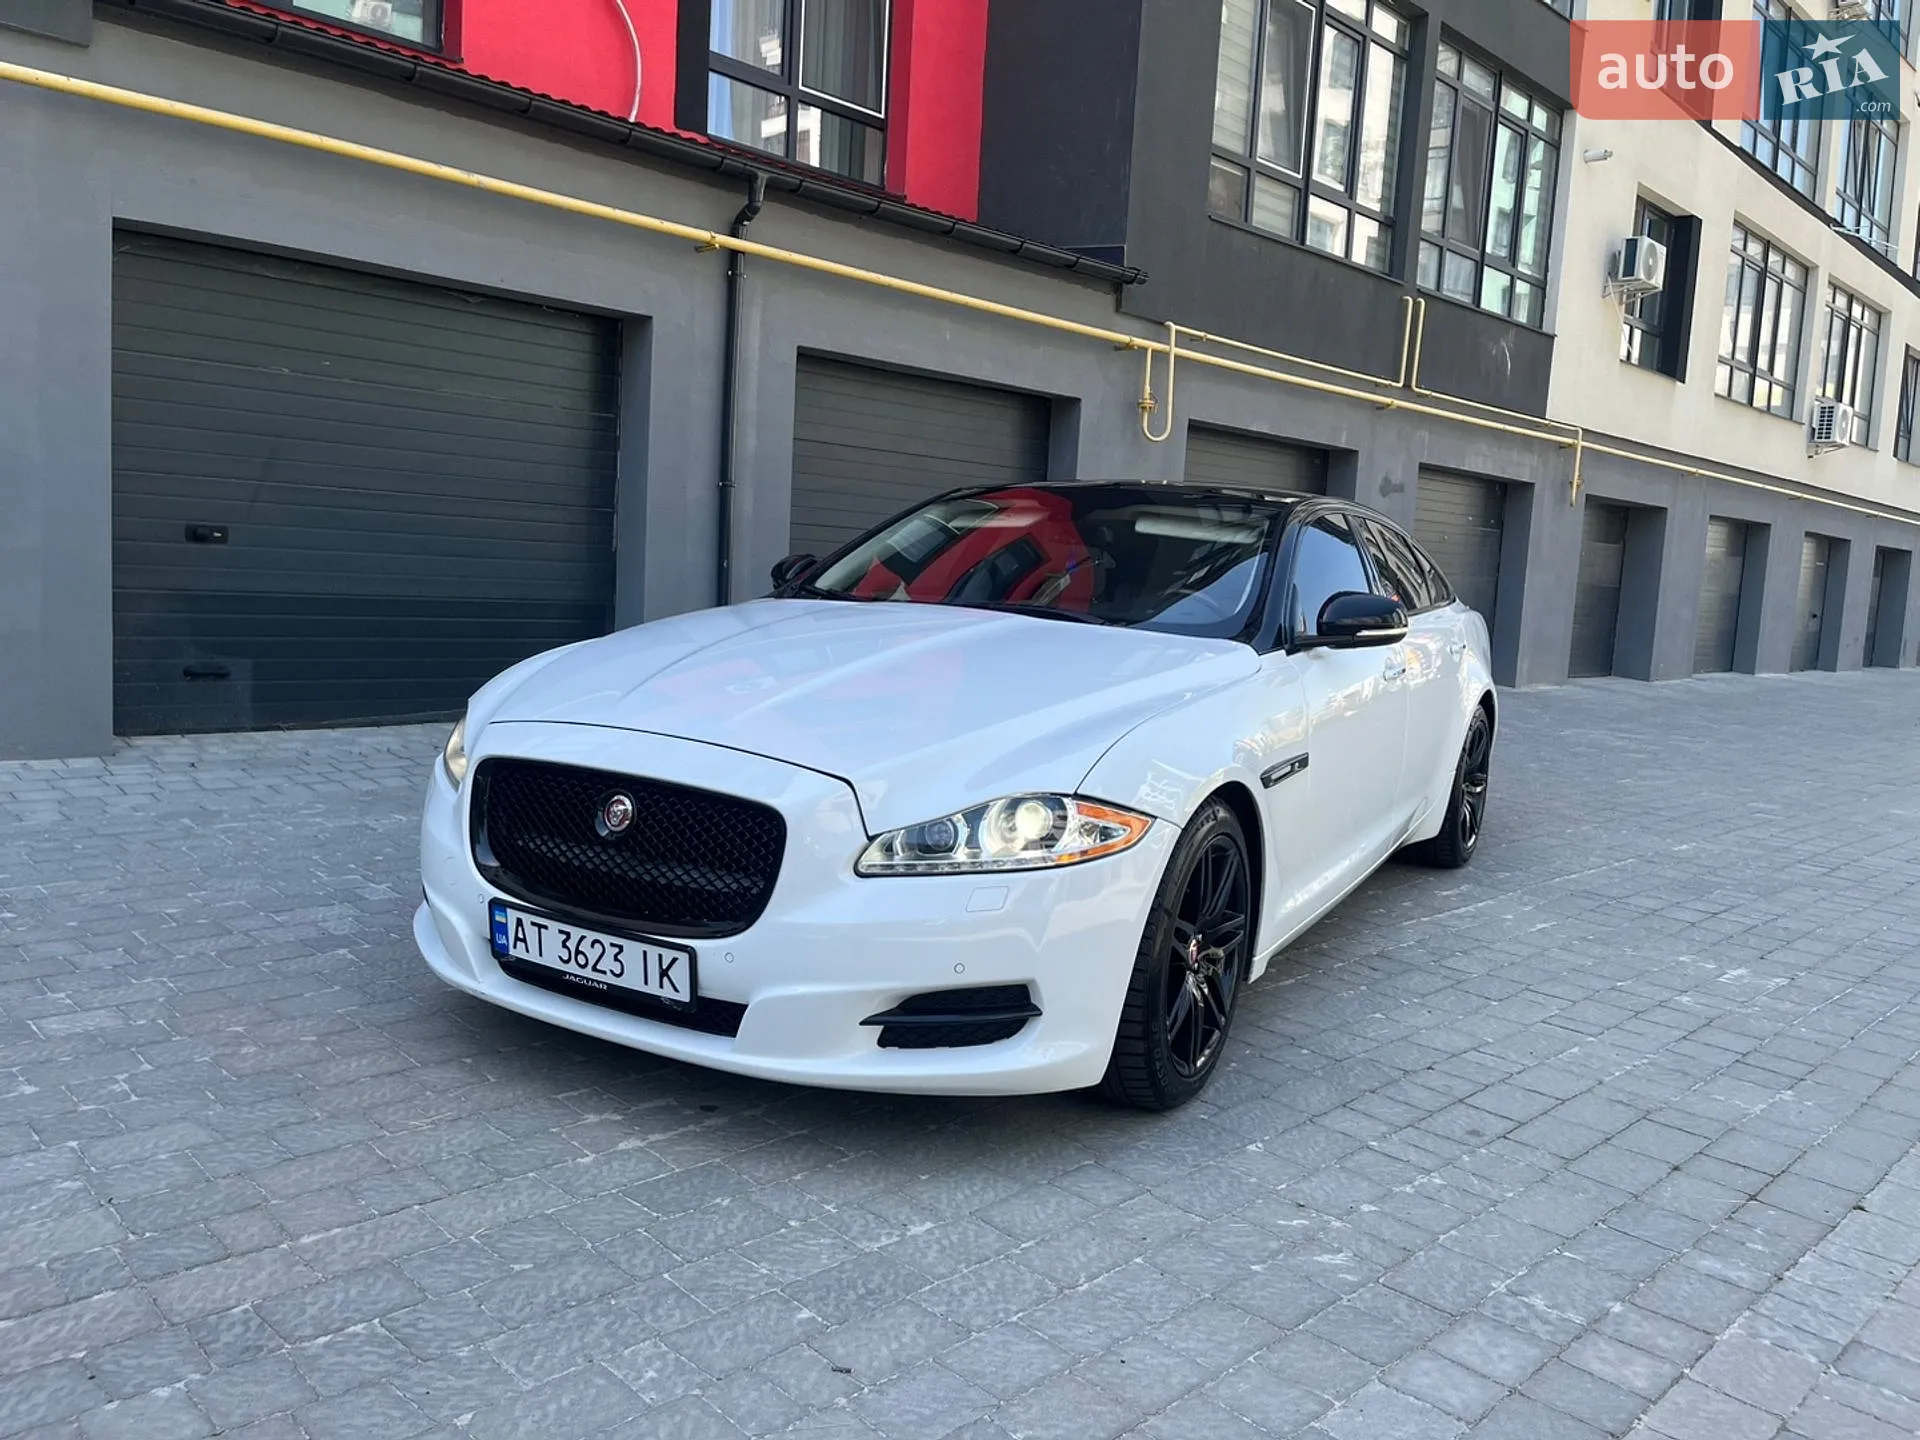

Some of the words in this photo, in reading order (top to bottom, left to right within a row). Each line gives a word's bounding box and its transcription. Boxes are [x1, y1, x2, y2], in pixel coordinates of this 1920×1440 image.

[495, 932, 508, 946] UA
[513, 916, 549, 958] AT
[557, 928, 625, 979] 3623
[642, 949, 681, 994] IK
[562, 973, 608, 991] JAGUAR
